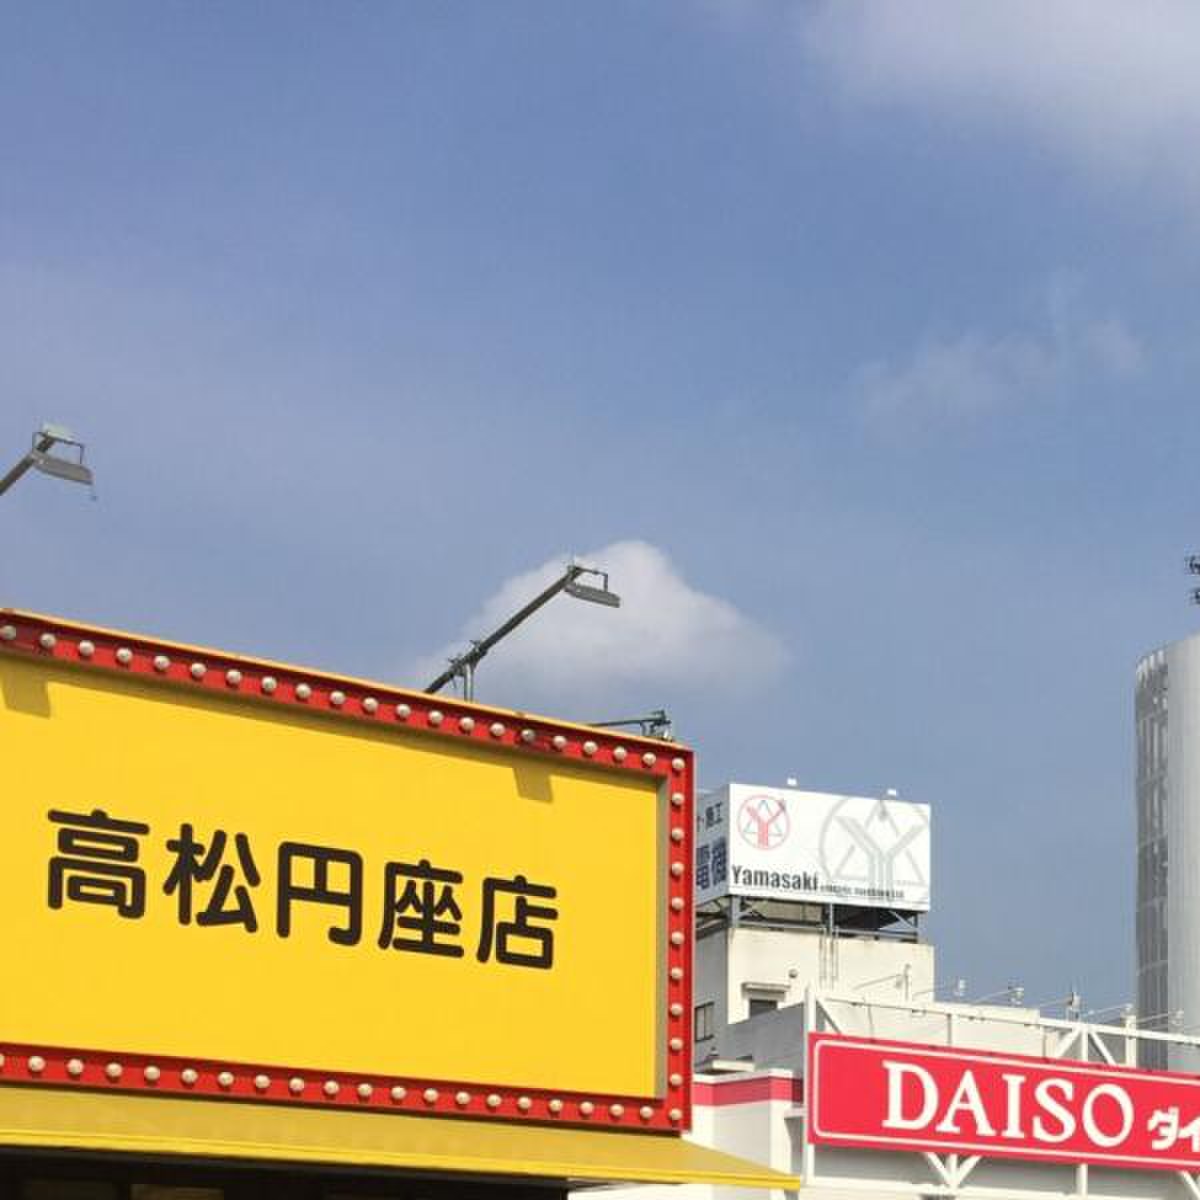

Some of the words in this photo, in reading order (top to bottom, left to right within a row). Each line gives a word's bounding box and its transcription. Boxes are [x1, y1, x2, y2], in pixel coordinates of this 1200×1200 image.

[47, 808, 559, 970] 高松円座店
[732, 865, 819, 892] Yamasaki
[881, 1060, 1135, 1147] DAISO
